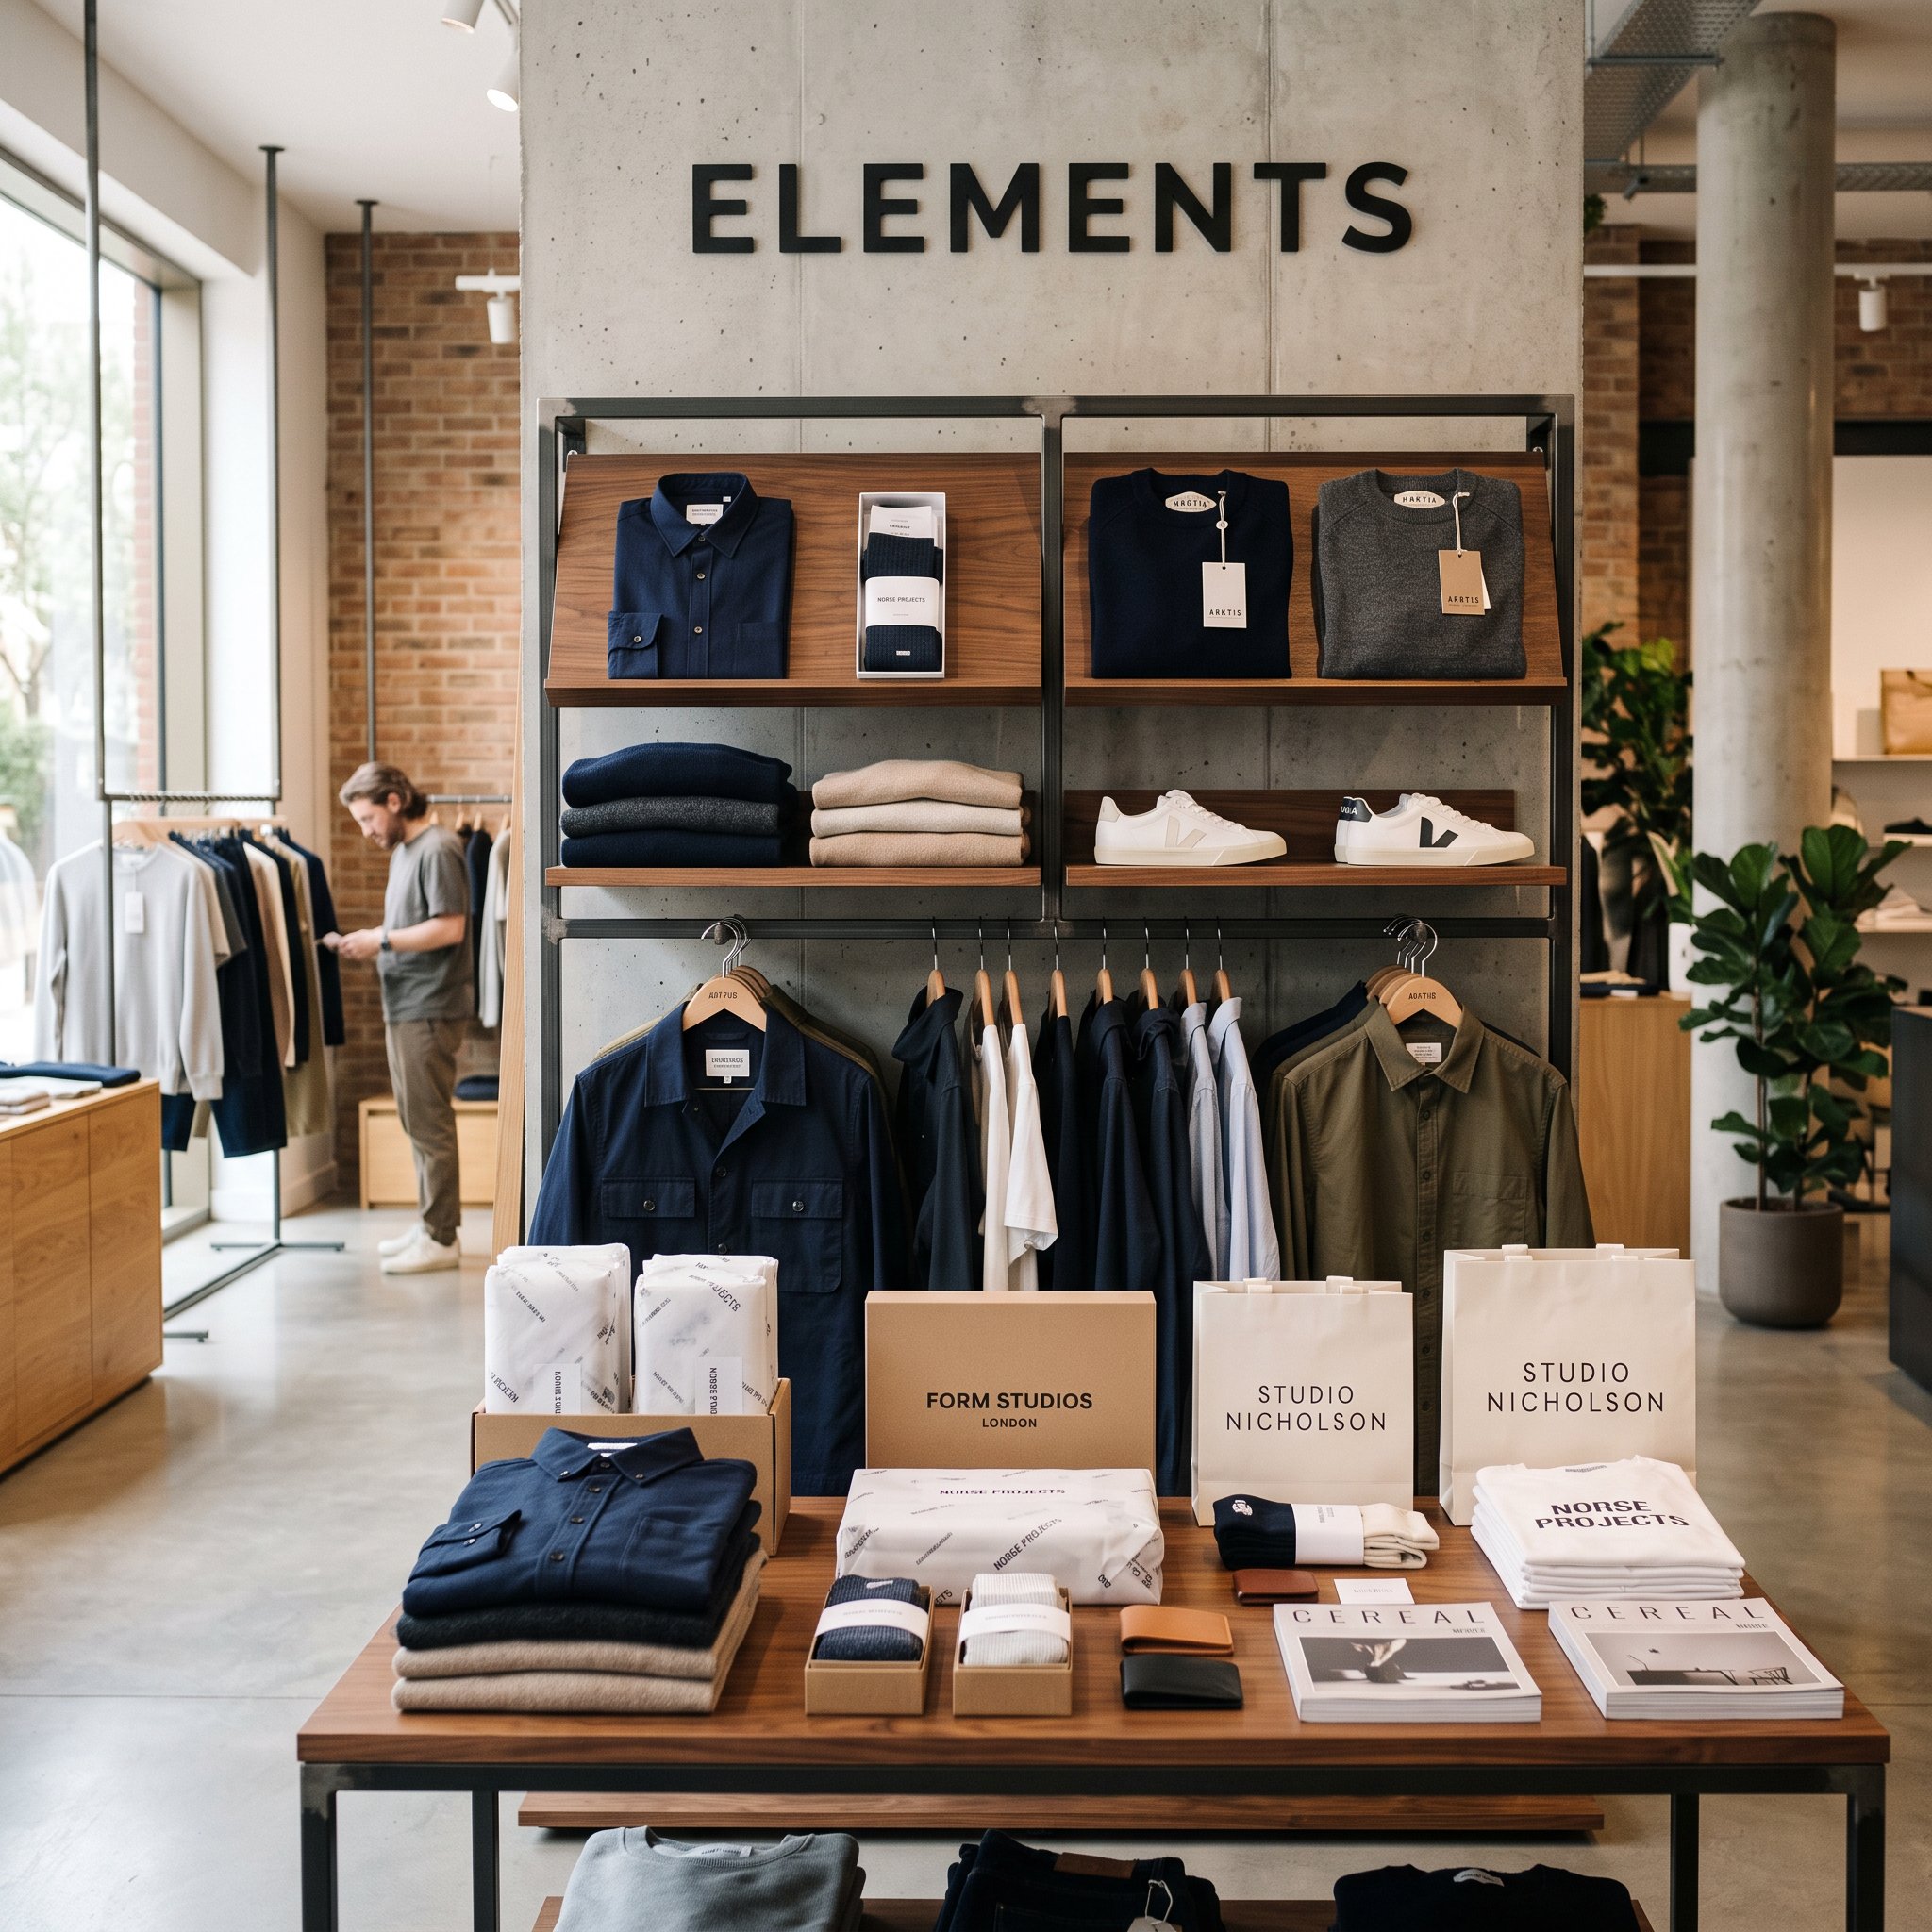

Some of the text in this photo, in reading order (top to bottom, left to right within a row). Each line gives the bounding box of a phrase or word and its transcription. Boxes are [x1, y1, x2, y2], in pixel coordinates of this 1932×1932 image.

[691, 161, 1414, 254] ELEMENTS
[1209, 608, 1241, 617] ARKTIS
[1524, 1362, 1629, 1383] STUDIO
[926, 1392, 1093, 1409] FORM STUDIOS
[1258, 1385, 1354, 1404] STUDIO
[1488, 1391, 1663, 1412] NICHOLSON
[982, 1418, 1037, 1427] LONDON
[1226, 1412, 1386, 1431] NICHOLSON
[1551, 1500, 1652, 1515] NORSE
[1535, 1513, 1690, 1529] PROJECTS
[1292, 1609, 1485, 1624] CEREAL
[1571, 1606, 1765, 1620] CEREAL
